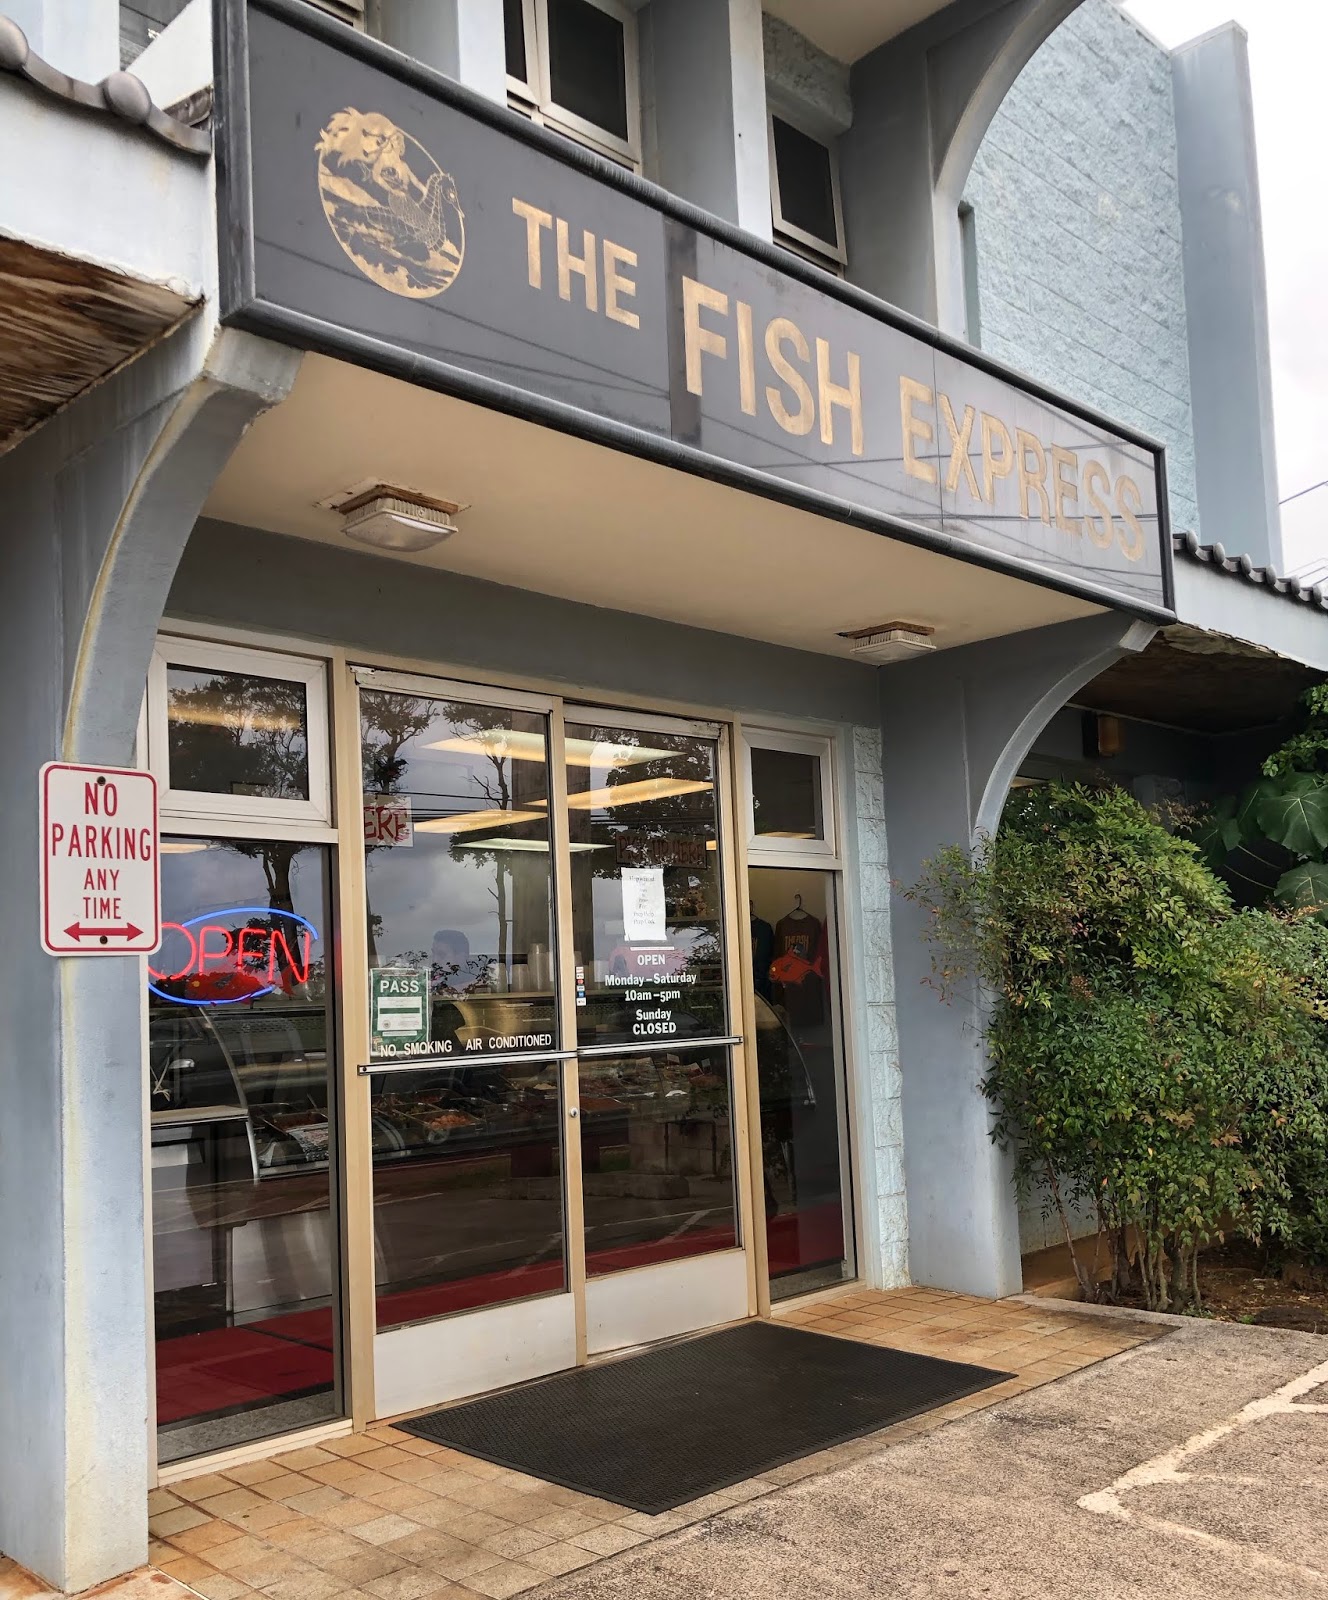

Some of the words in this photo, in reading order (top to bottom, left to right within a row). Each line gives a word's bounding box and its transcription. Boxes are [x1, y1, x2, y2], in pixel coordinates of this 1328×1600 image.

[512, 197, 640, 330] THE
[682, 275, 864, 457] FISH
[899, 375, 1145, 563] EXPRESS
[85, 781, 118, 817] NO
[51, 822, 151, 862] PARKING
[84, 868, 120, 891] ANY
[83, 897, 121, 919] TIME
[148, 921, 311, 984] OPEN
[637, 954, 666, 966] OPEN
[380, 980, 419, 993] PASS
[636, 1008, 672, 1021] Sunday
[632, 1022, 677, 1035] CLOSED
[380, 1044, 397, 1057] NO
[404, 1040, 453, 1056] SMOKING
[465, 1038, 483, 1051] AIR
[488, 1034, 552, 1049] CONDITIONED
